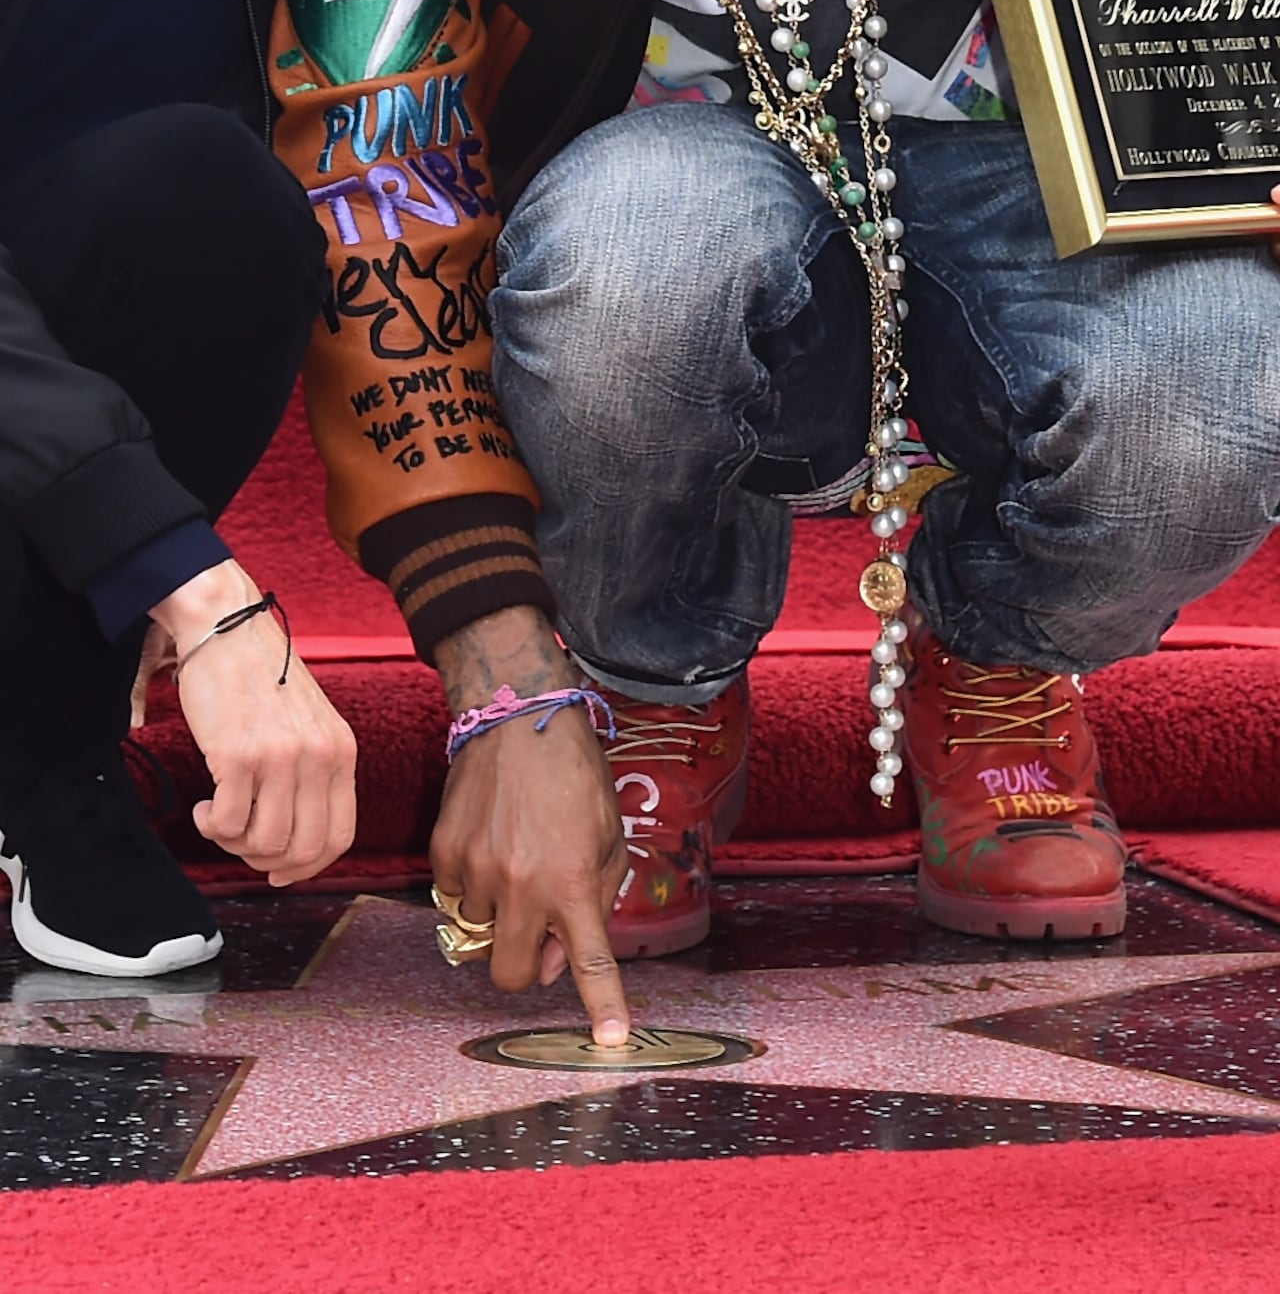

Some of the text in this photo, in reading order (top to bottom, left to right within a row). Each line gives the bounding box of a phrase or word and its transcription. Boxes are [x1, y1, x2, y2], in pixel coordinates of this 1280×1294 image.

[1115, 42, 1133, 56] THE
[1192, 38, 1209, 53] THE
[1106, 64, 1215, 93] HOLLYWOOD
[1223, 61, 1278, 87] WALK
[316, 73, 474, 174] PUNK
[350, 384, 386, 417] WE
[364, 412, 425, 454] YOUR
[393, 442, 426, 473] TO
[434, 433, 473, 458] BE
[976, 760, 1058, 796] PUNK
[986, 792, 1079, 819] TRIBE
